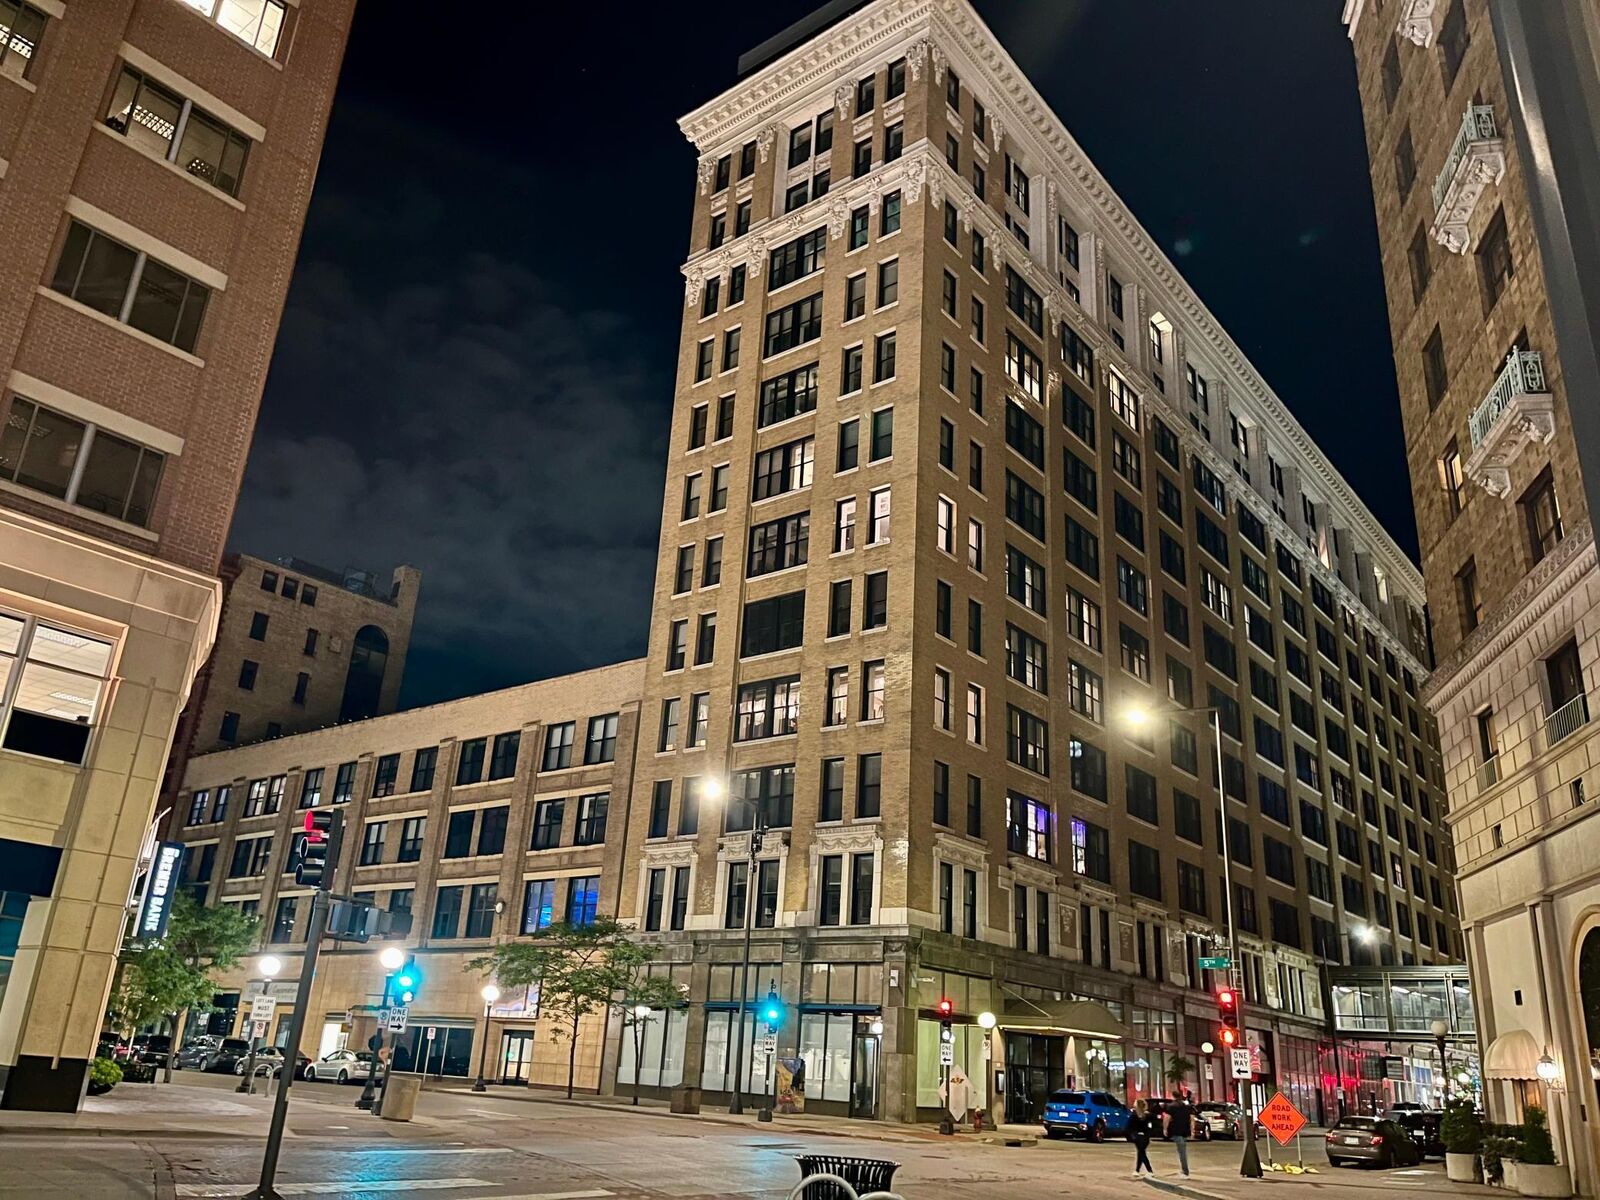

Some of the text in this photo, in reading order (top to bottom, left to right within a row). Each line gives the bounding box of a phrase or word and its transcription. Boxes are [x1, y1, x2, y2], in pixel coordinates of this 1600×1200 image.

[144, 847, 177, 931] BREMER BANK
[1204, 959, 1216, 967] 5TH
[1271, 1104, 1291, 1112] ROAD
[1271, 1123, 1295, 1131] AHEAD
